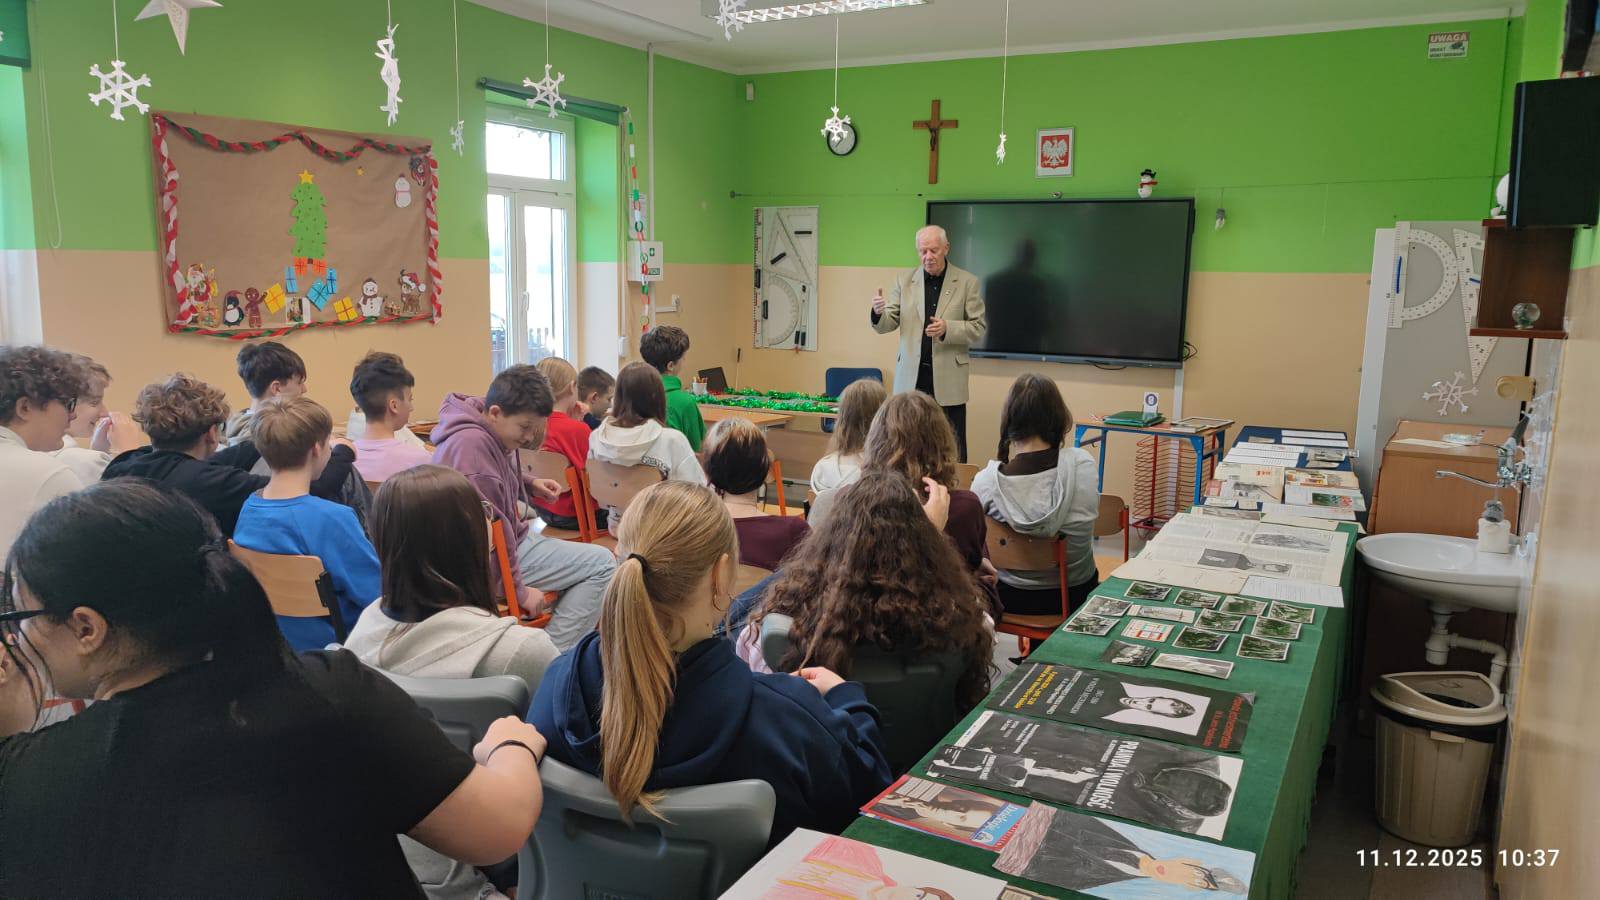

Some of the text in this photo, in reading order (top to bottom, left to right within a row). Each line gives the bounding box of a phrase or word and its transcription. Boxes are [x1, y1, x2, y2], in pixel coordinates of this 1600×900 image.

[1430, 33, 1467, 42] UWAGA
[1108, 740, 1140, 768] PRAWDA
[1086, 772, 1124, 809] WOLNOŚĆ
